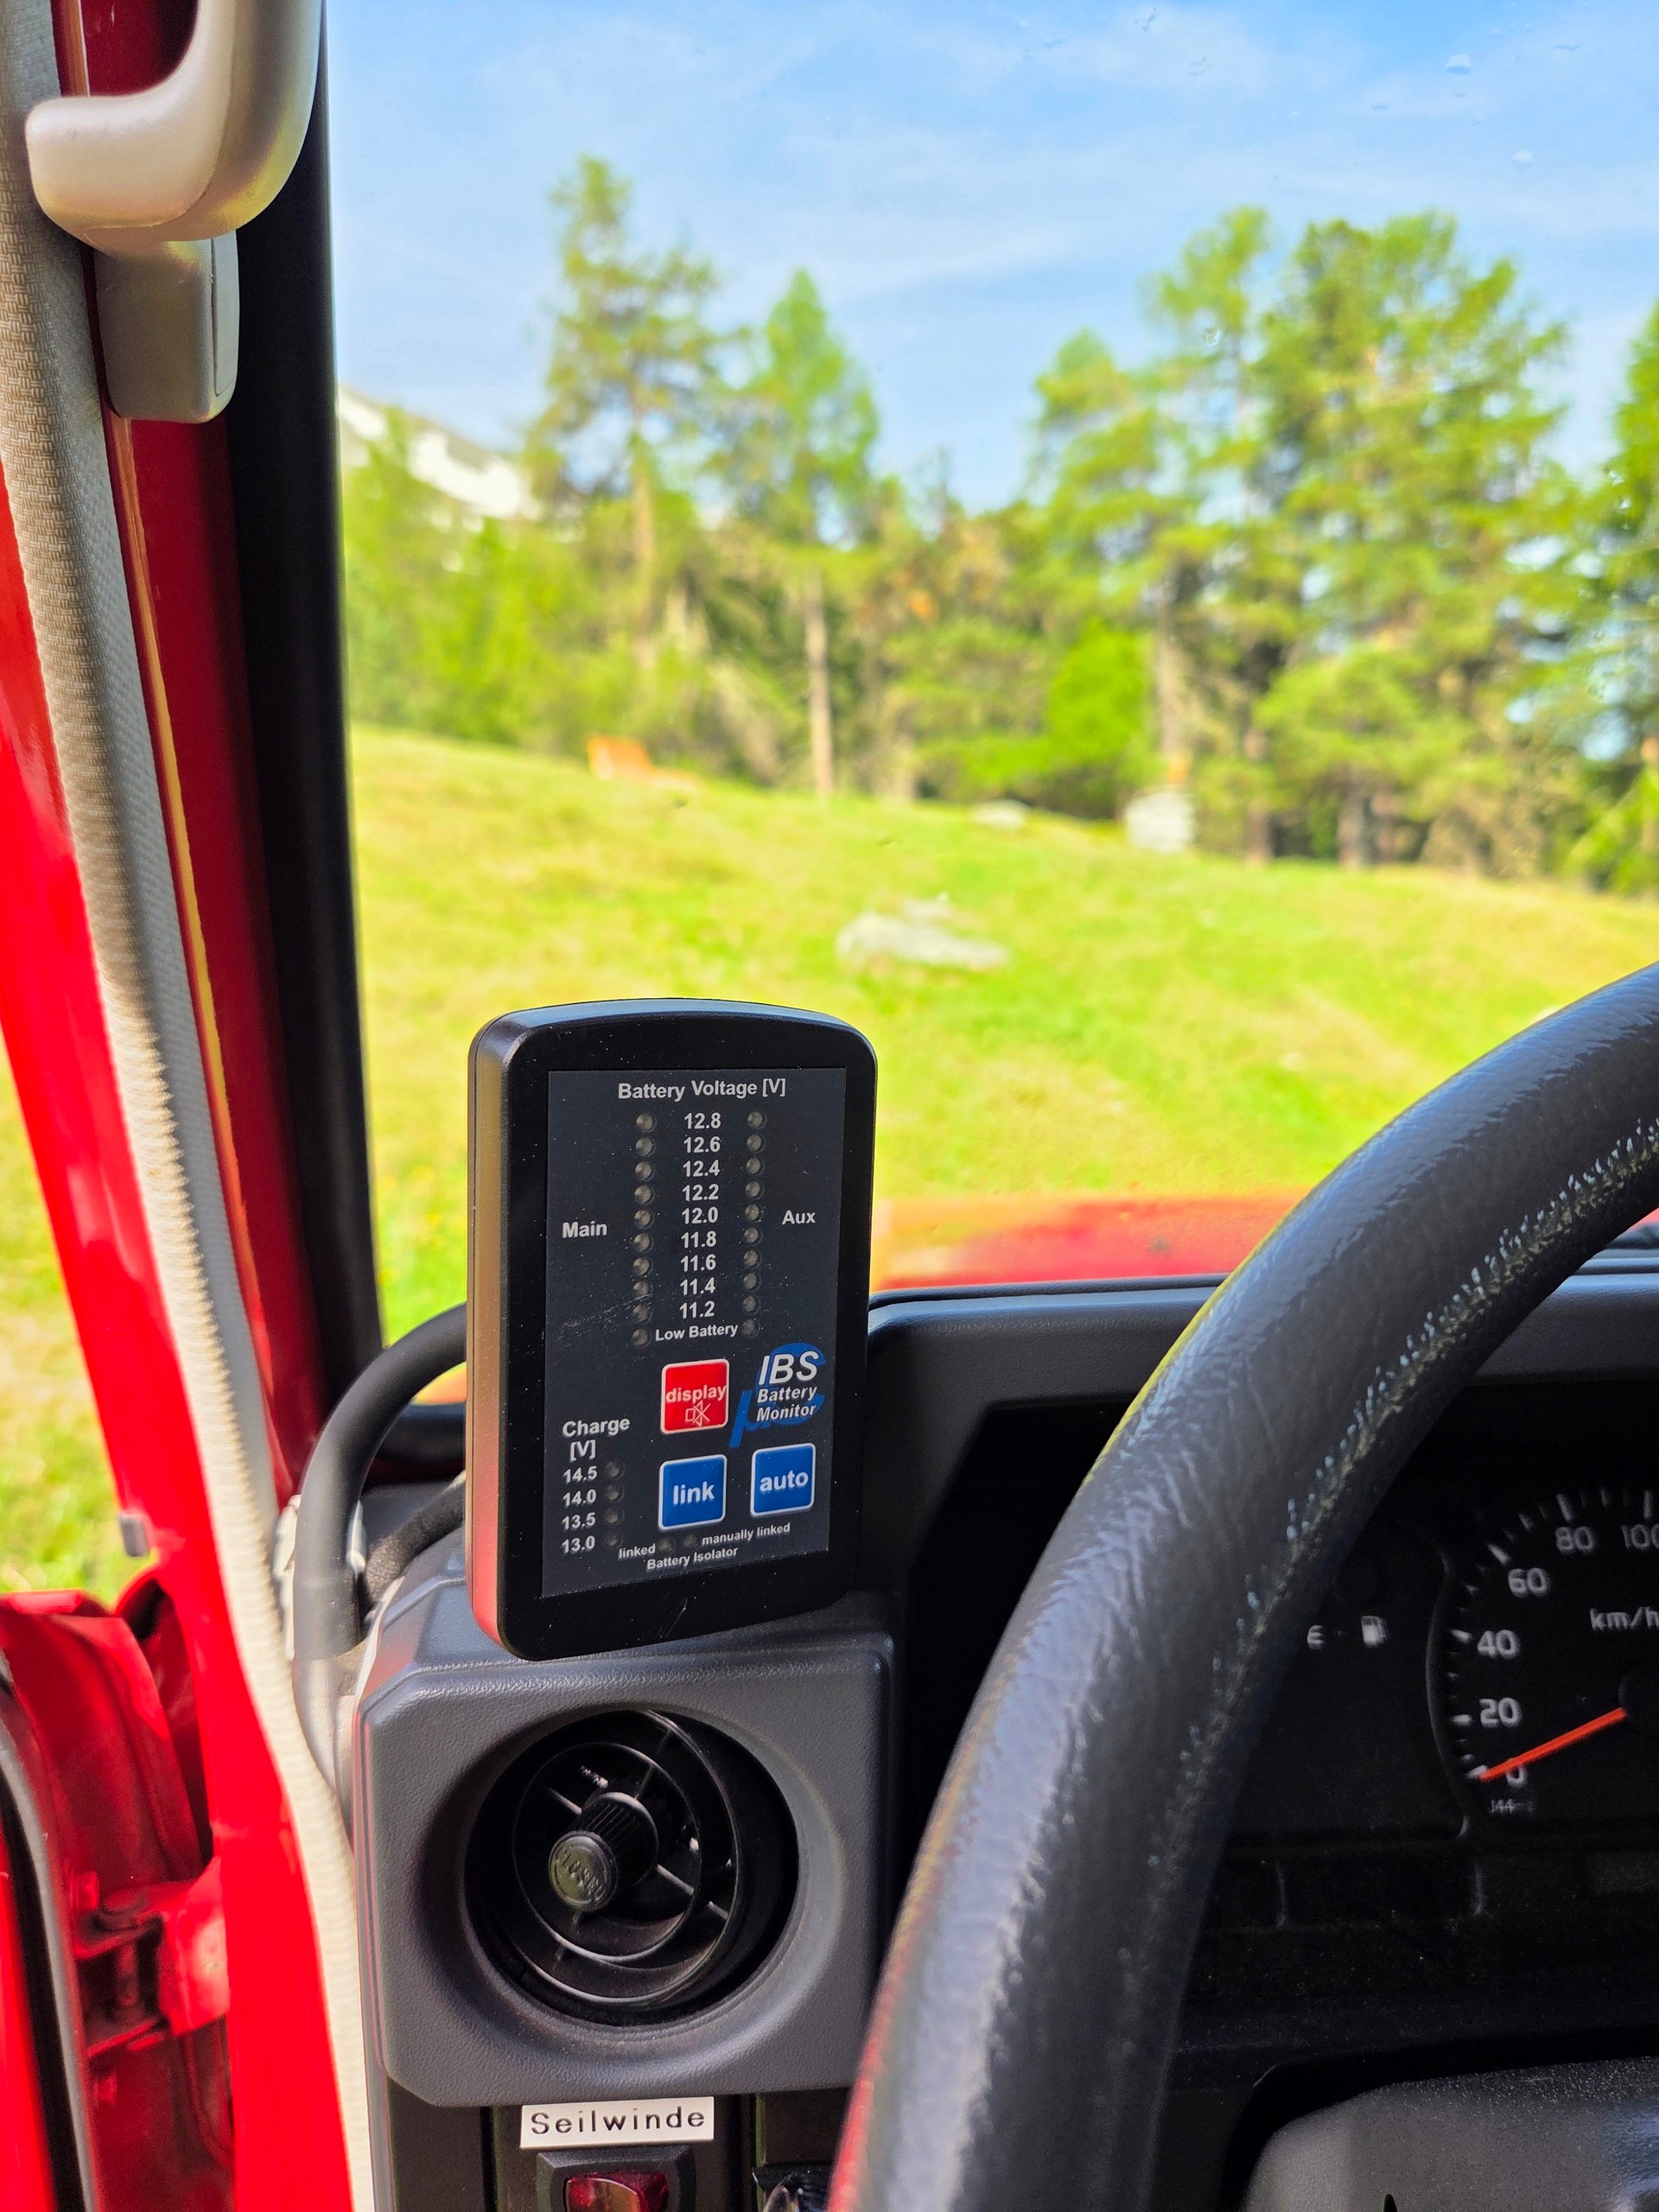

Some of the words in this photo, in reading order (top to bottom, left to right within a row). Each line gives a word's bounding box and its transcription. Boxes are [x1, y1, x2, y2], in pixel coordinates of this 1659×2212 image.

[618, 1083, 685, 1102] Battery
[691, 1080, 758, 1098] Voltage
[762, 1078, 786, 1097] [V]
[684, 1112, 721, 1129] 12.8
[683, 1135, 721, 1153] 12.6
[683, 1160, 720, 1177] 12.4
[682, 1184, 719, 1201] 12.2
[682, 1207, 719, 1224] 12.0
[782, 1210, 816, 1225] Aux
[563, 1221, 607, 1238] Main
[681, 1230, 717, 1248] 11.8
[680, 1255, 716, 1272] 11.6
[680, 1277, 716, 1295] 11.4
[679, 1300, 715, 1319] 11.2
[655, 1326, 684, 1341] Low
[689, 1324, 738, 1338] Battery
[759, 1351, 819, 1385] IBS
[665, 1383, 728, 1405] display
[757, 1386, 817, 1403] Battery
[757, 1403, 817, 1422] Monitor
[563, 1418, 630, 1439] Charge
[569, 1440, 596, 1462] [V]
[563, 1465, 598, 1484] 14.5
[760, 1471, 809, 1492] auto
[563, 1489, 597, 1507] 14.0
[673, 1481, 715, 1506] link
[563, 1512, 596, 1530] 13.5
[702, 1528, 753, 1546] manually
[756, 1522, 791, 1538] linked
[1555, 1526, 1595, 1554] 80
[562, 1535, 596, 1554] 13.0
[619, 1543, 656, 1560] linked
[646, 1554, 690, 1571] Battery
[694, 1547, 738, 1563] Isolator
[1507, 1567, 1550, 1598] 60
[1590, 1606, 1659, 1631] km/h
[1477, 1629, 1521, 1660] 40
[1479, 1697, 1522, 1727] 20
[531, 2106, 705, 2134] Seilwinde
